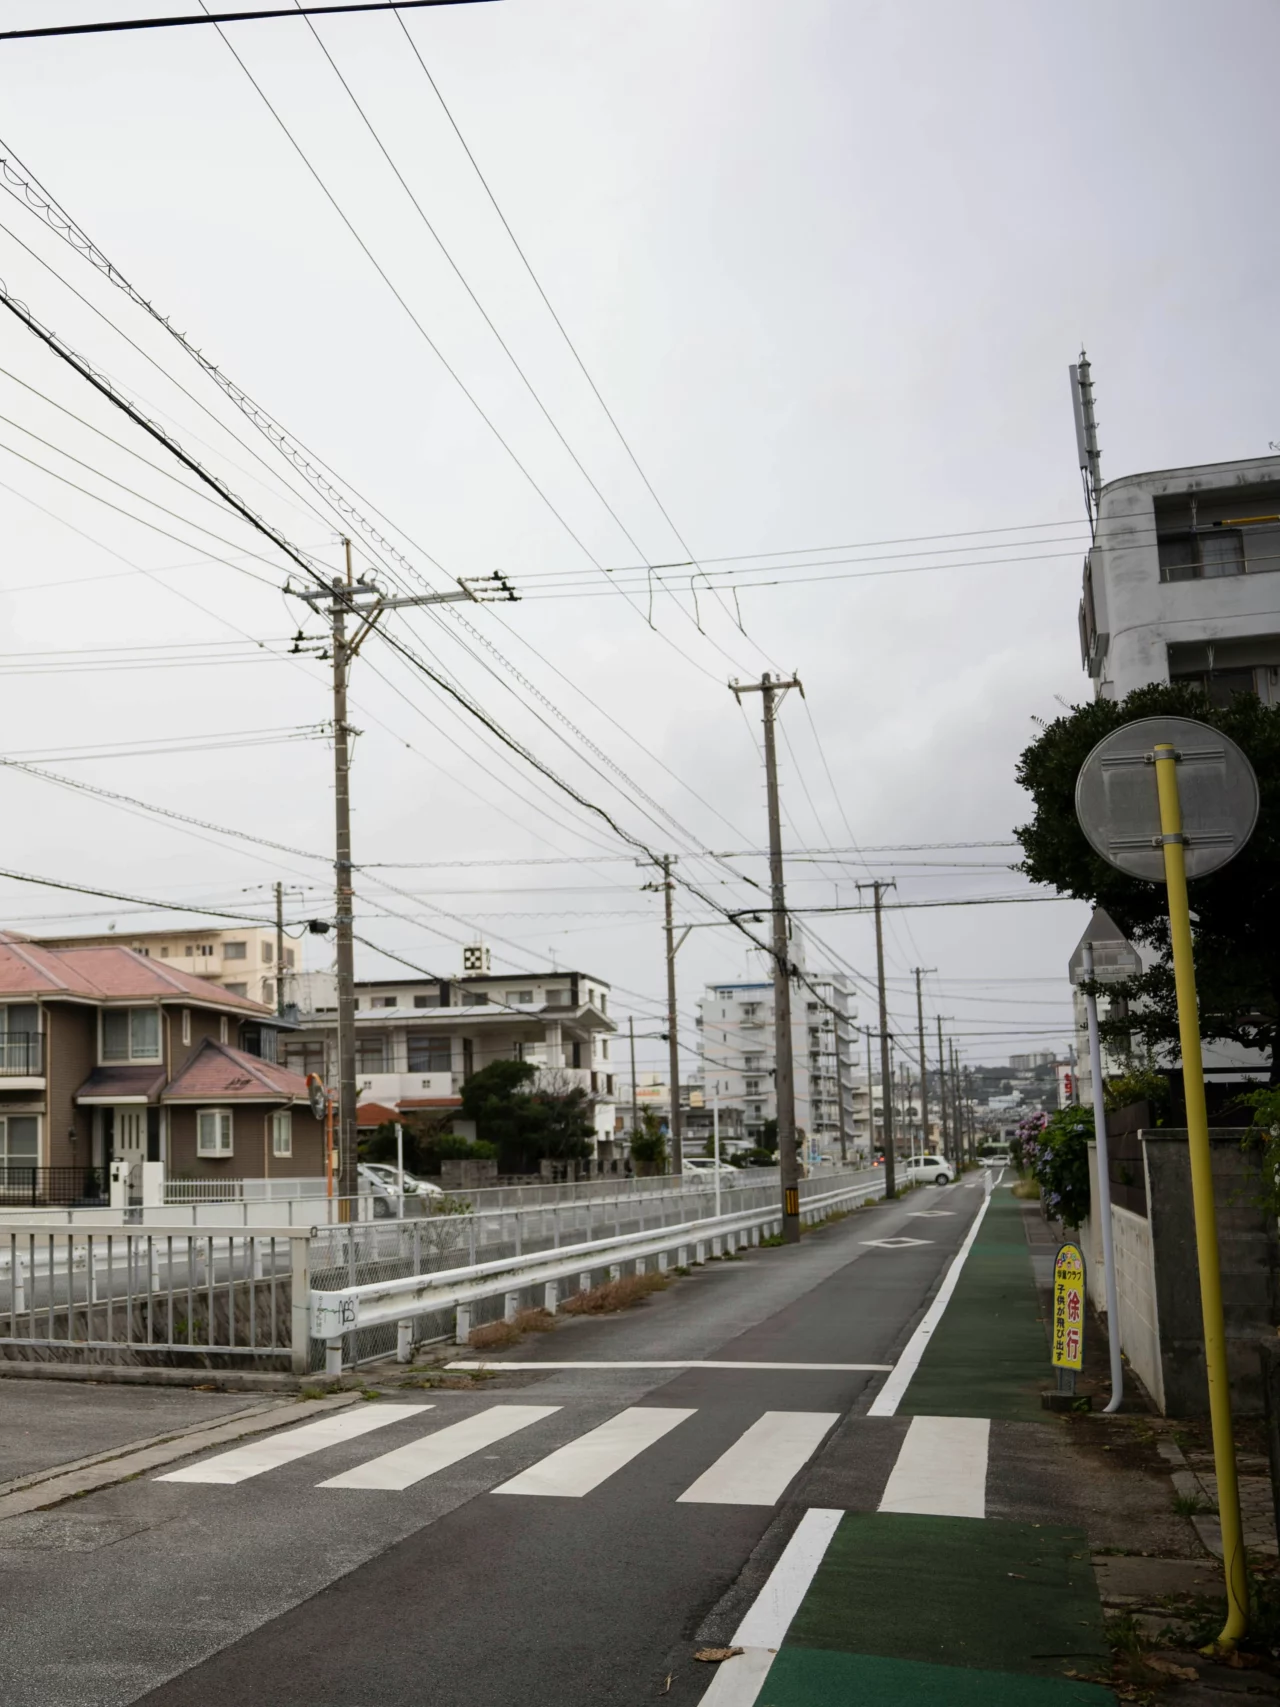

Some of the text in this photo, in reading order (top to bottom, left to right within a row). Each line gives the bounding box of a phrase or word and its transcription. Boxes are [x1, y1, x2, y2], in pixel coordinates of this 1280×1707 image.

[1057, 1269, 1082, 1281] 学童クラブ
[1056, 1284, 1065, 1361] 子供が飛び出す
[1066, 1289, 1080, 1361] 徐行
